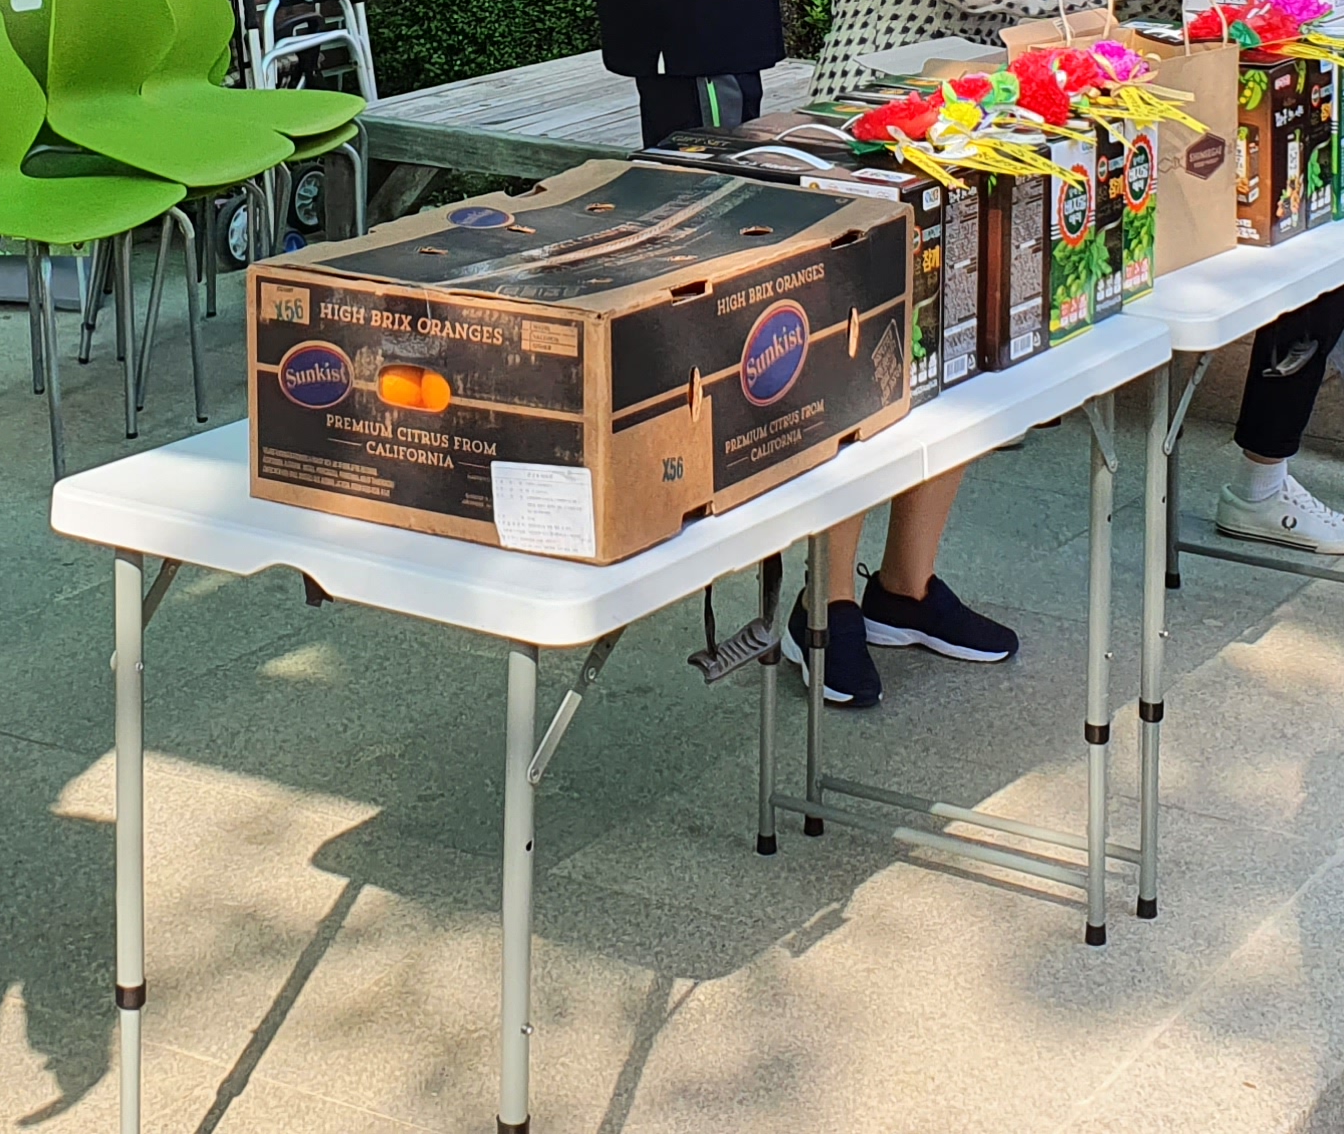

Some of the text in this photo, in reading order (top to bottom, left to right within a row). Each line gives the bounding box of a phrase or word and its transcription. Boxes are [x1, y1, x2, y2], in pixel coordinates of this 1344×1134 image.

[717, 263, 825, 316] HIGH BRIX ORANGES
[320, 302, 503, 346] HIGH BRIX ORANGES
[285, 361, 348, 390] Sunkist
[745, 322, 804, 387] Sunkist
[326, 413, 497, 456] PREMIUM CITRUS FROM
[725, 399, 825, 455] PREMIUM CITRUS FROM
[750, 428, 804, 462] CALIFORNIA
[366, 441, 454, 469] CALIFORNIA
[662, 456, 684, 483] X56
